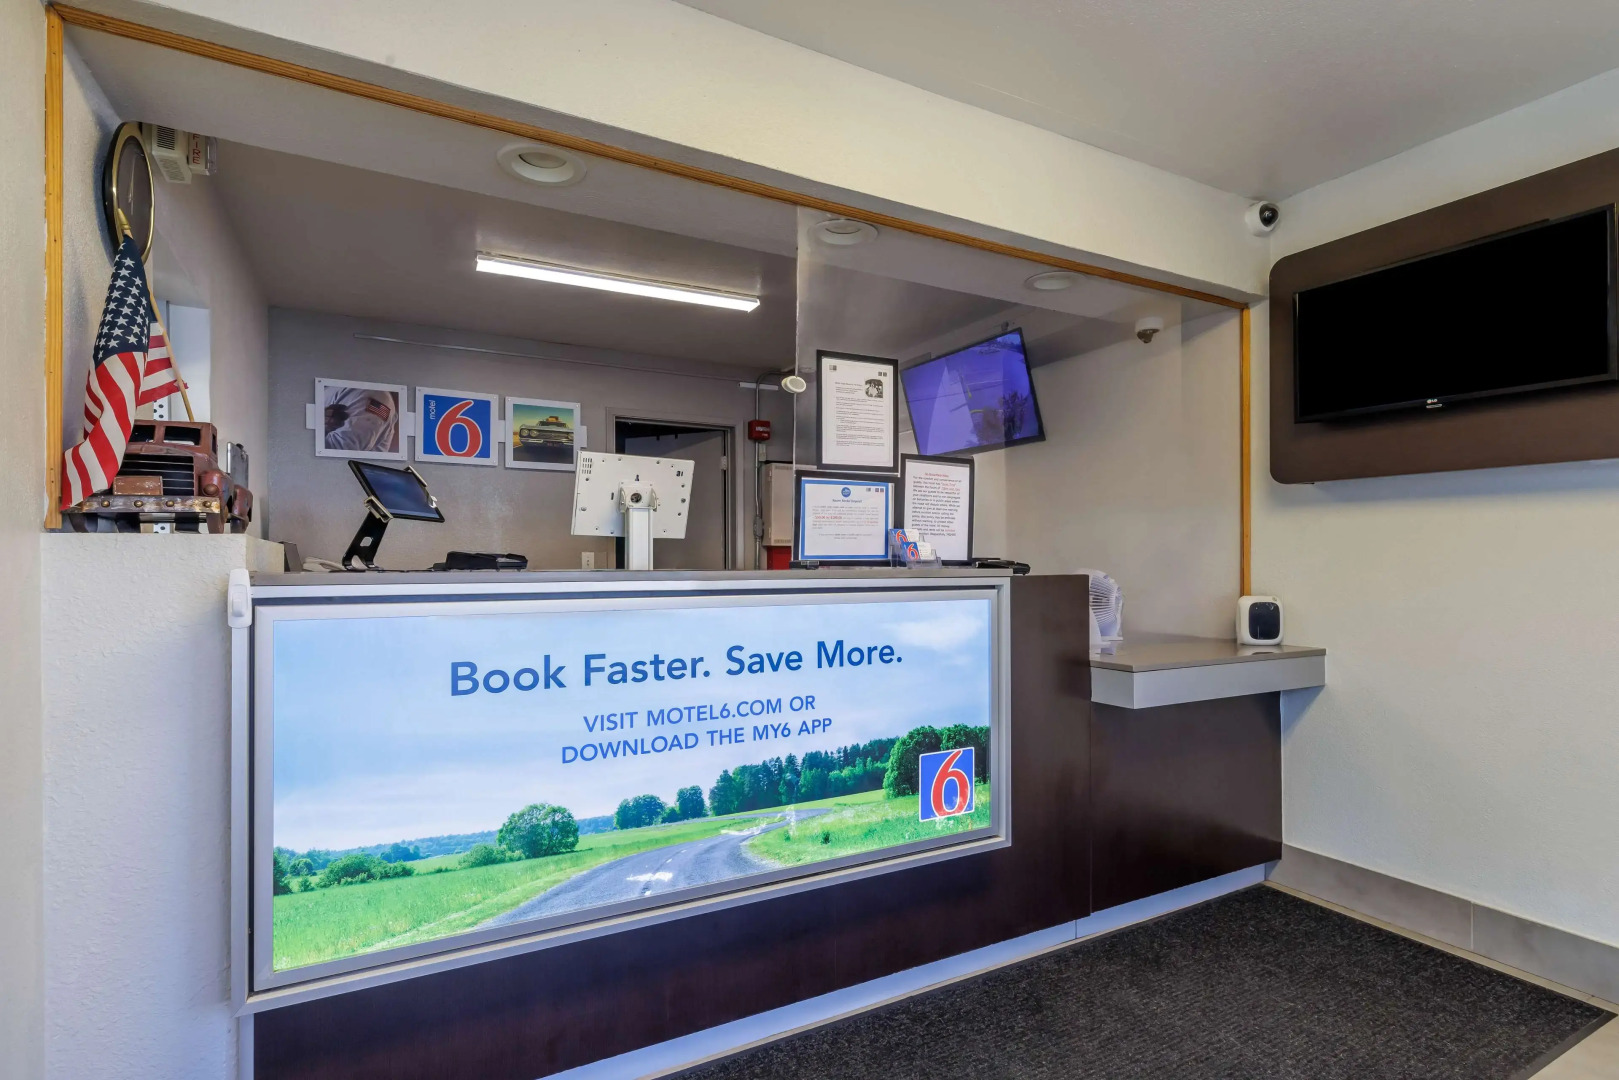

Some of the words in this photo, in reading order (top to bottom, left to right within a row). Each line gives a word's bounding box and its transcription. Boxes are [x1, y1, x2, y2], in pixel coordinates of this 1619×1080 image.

[192, 133, 201, 165] FIRE
[434, 399, 483, 458] 6
[907, 543, 919, 561] 6
[450, 654, 567, 697] Book
[584, 653, 711, 686] Faster.
[725, 645, 803, 676] Save
[816, 640, 903, 669] More.
[583, 711, 638, 733] VISIT
[647, 698, 783, 727] MOTEL6.COM
[789, 695, 816, 712] OR
[562, 732, 700, 764] DOWNLOAD
[706, 727, 745, 747] THE
[752, 722, 792, 741] MY6
[797, 717, 832, 735] APP
[931, 749, 970, 818] 6
